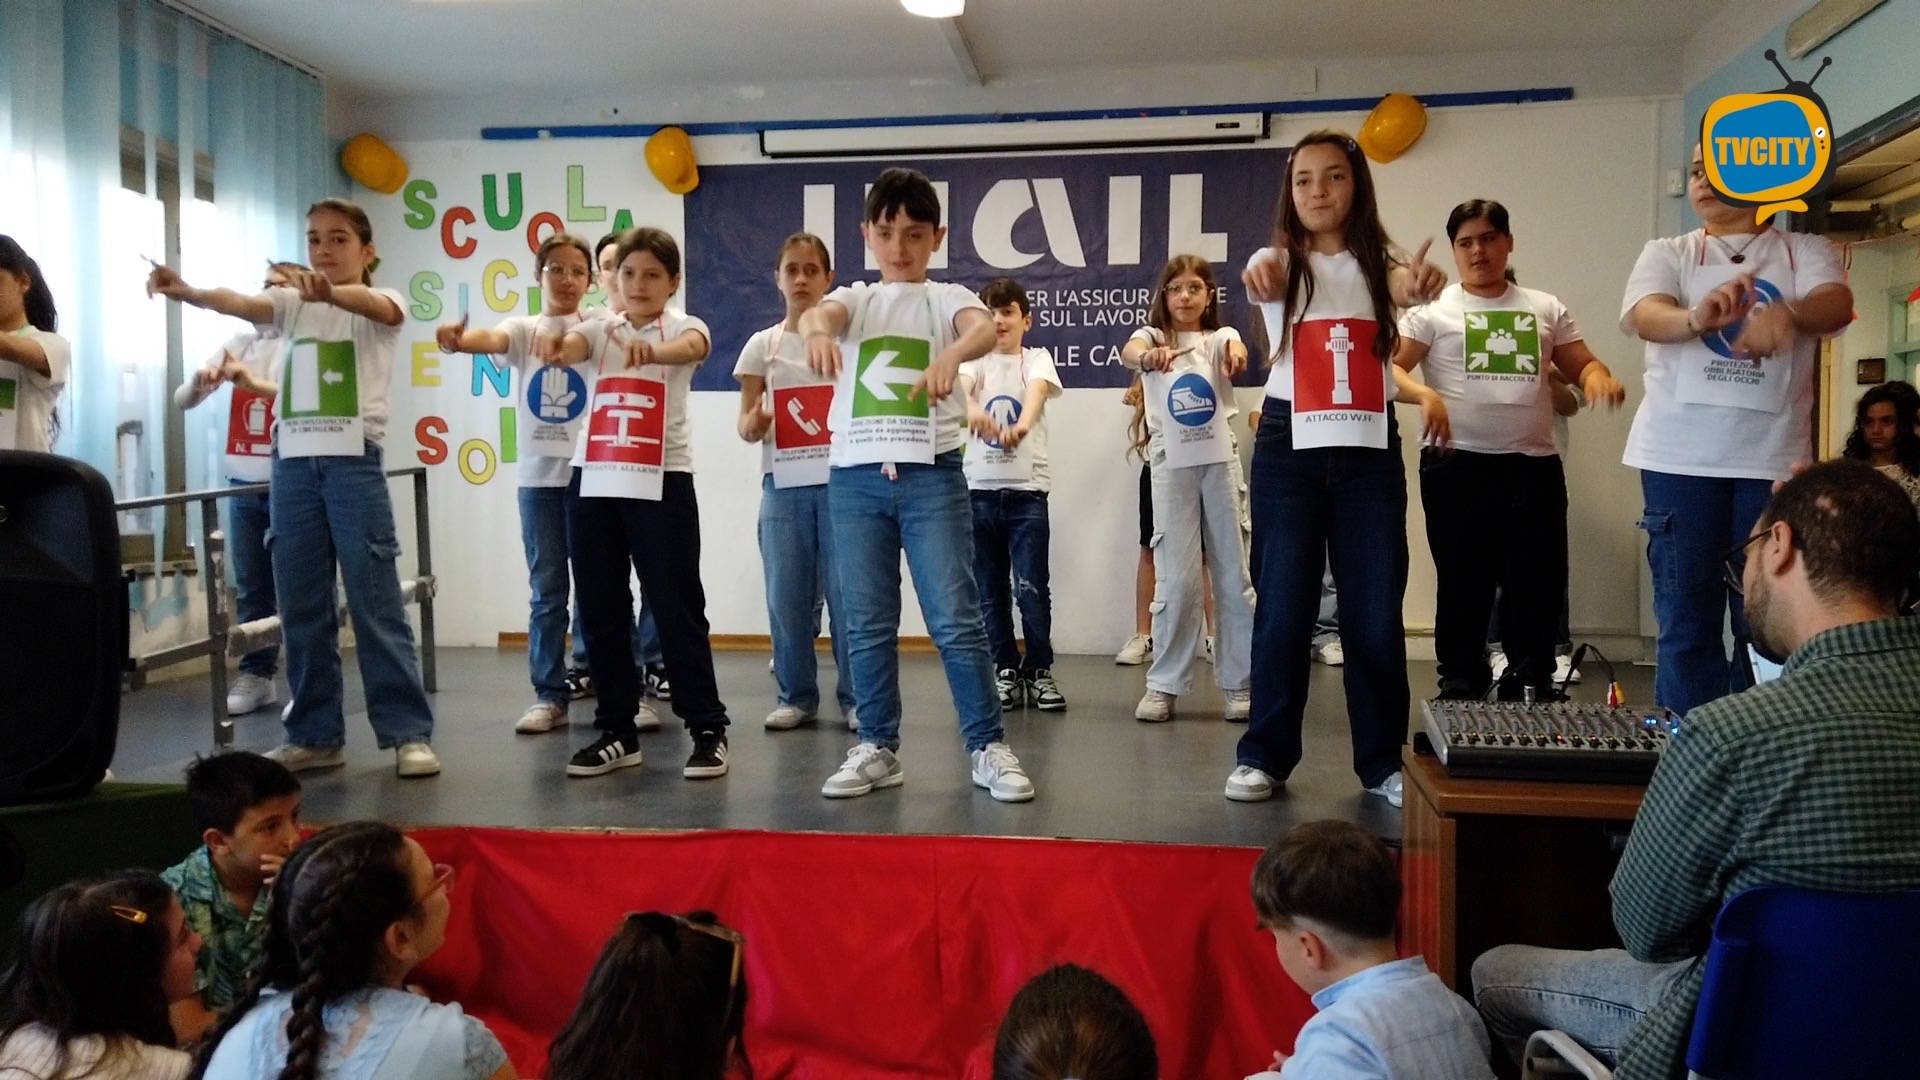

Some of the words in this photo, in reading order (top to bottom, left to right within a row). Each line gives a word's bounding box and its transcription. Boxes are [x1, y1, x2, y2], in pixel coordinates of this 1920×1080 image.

[1039, 310, 1077, 327] SUL
[1084, 308, 1154, 326] LAVOR
[1305, 413, 1348, 423] ATTACCO
